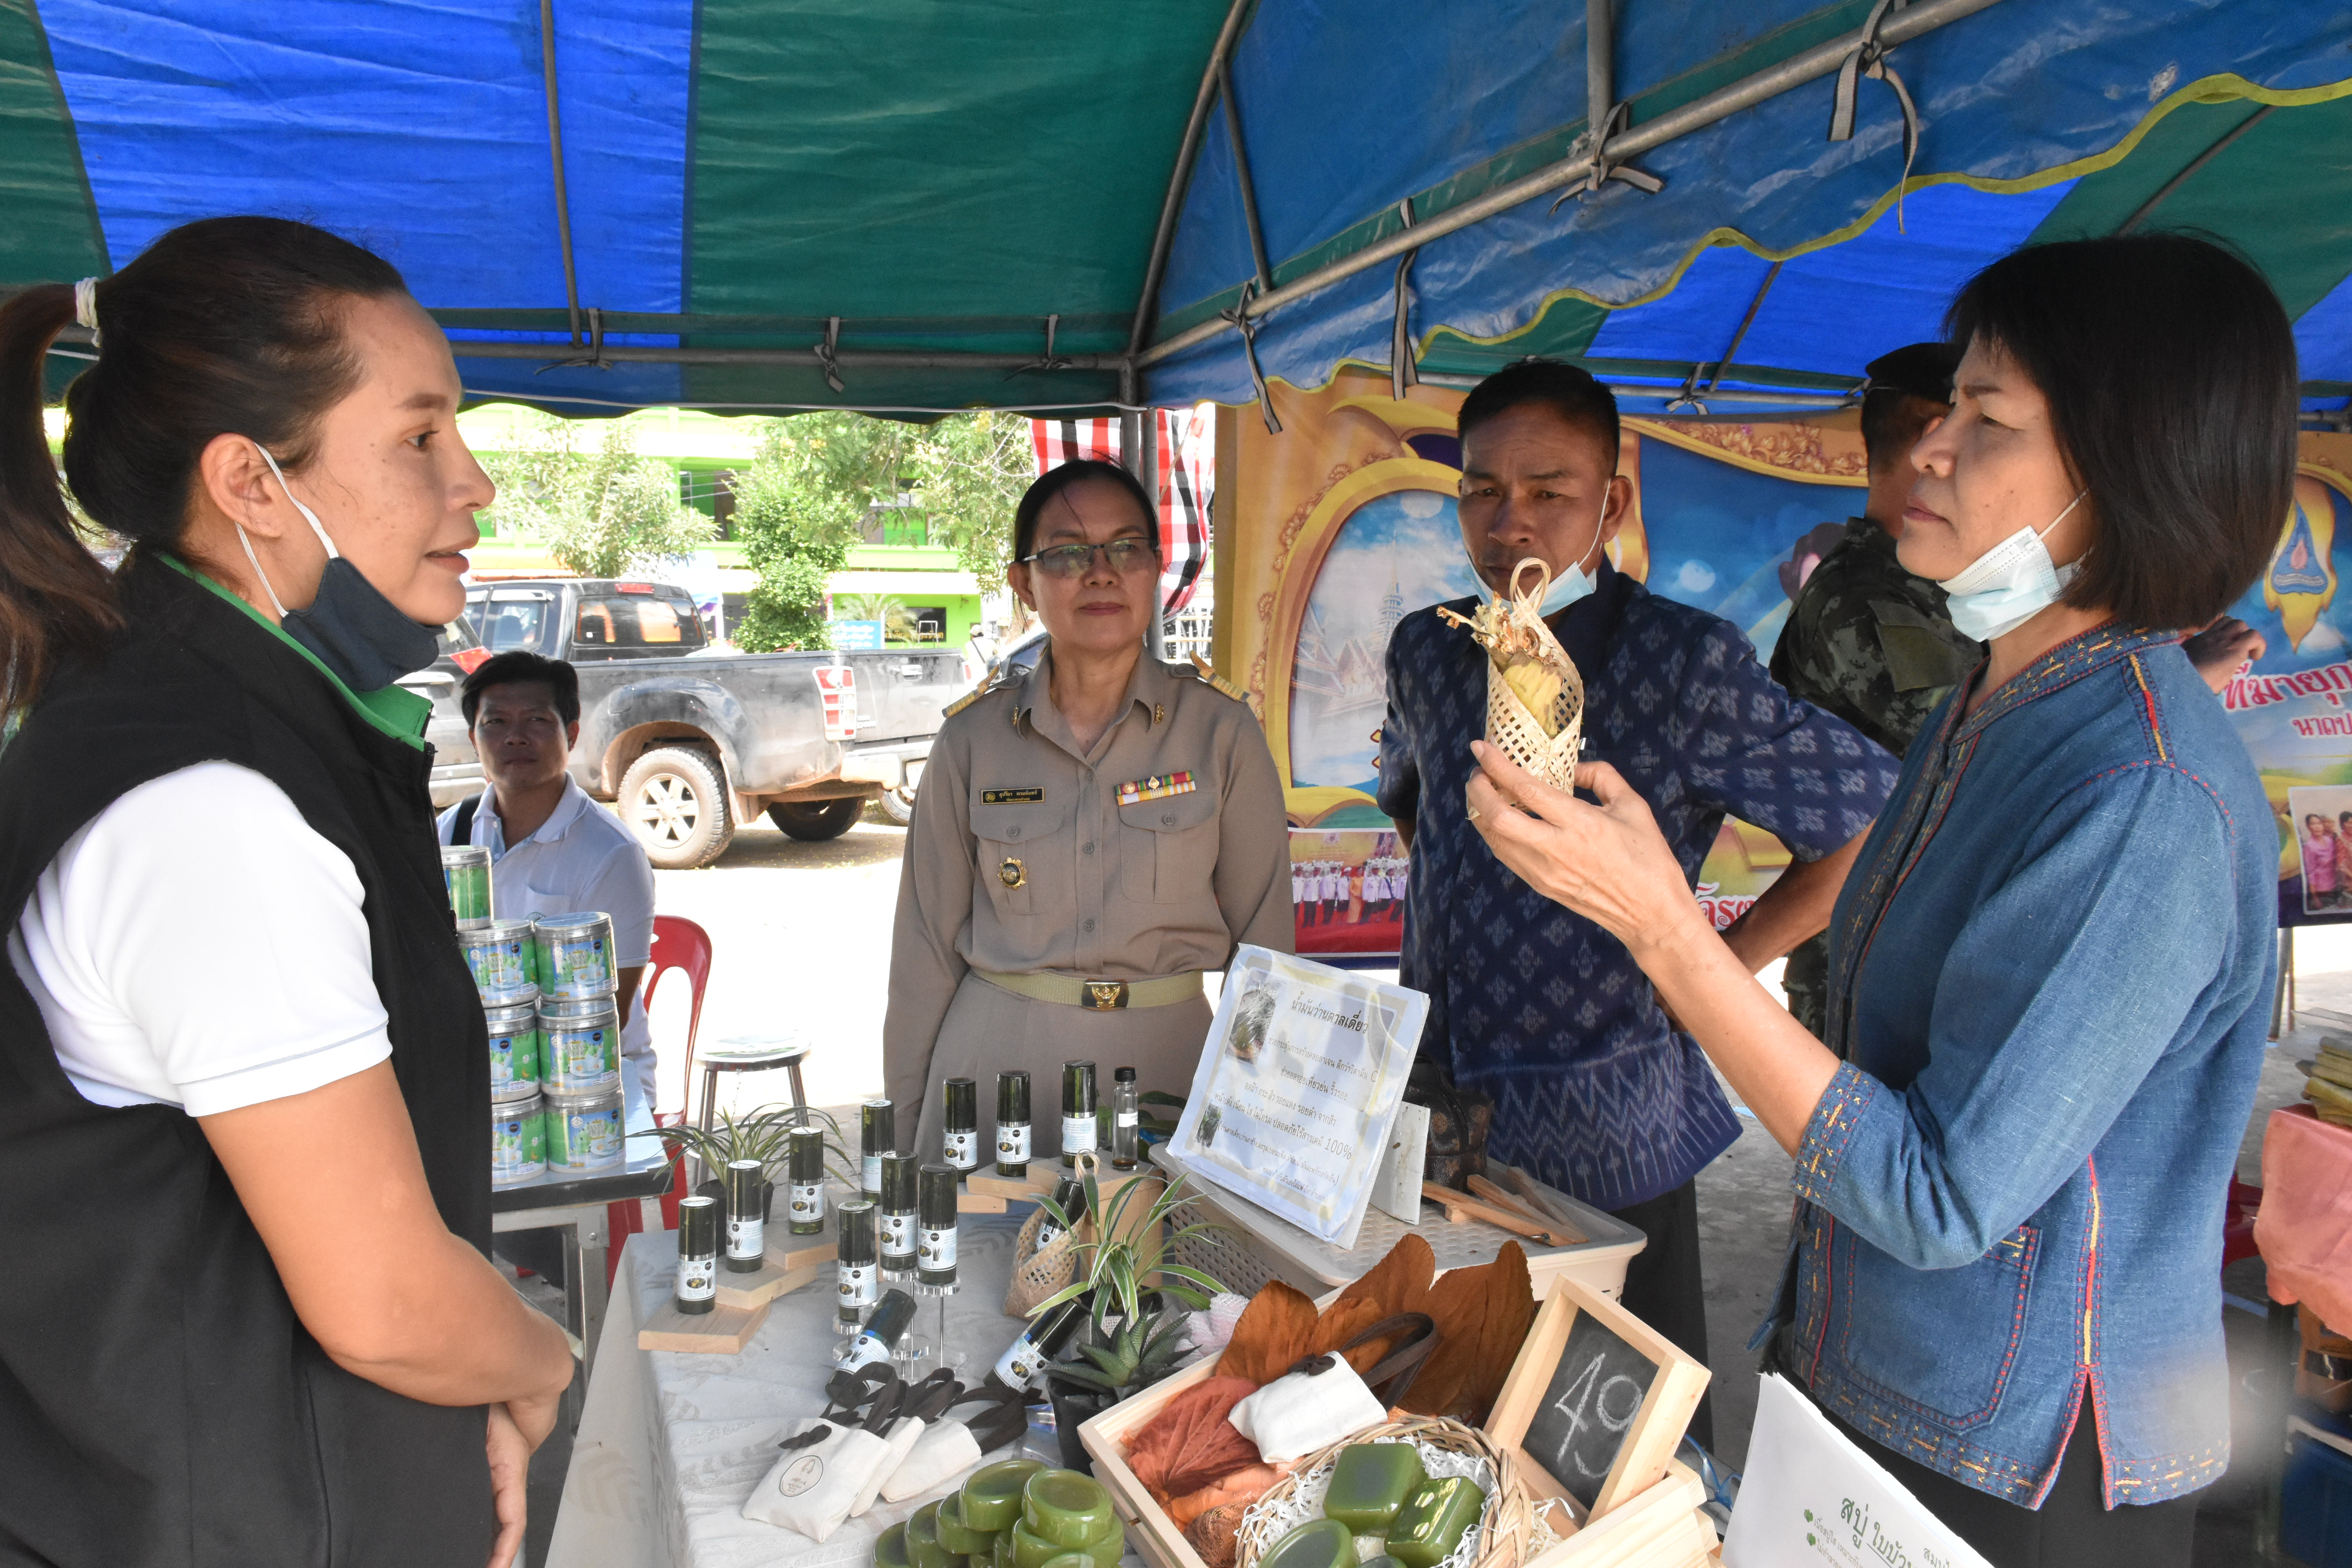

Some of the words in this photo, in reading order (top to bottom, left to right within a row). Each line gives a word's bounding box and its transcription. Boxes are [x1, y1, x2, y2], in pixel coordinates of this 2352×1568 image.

[1291, 991, 1368, 1033] น้ำมันว่านตาลเดี่ยว
[1280, 1066, 1328, 1093] ช่วยลดรอยเหี่ยวย่น
[1330, 1081, 1348, 1101] ริ้วรอย
[1258, 1089, 1268, 1098] กระ
[1276, 1096, 1296, 1111] รอยแดง
[1298, 1103, 1317, 1119] รอยดำ
[1318, 1112, 1337, 1127] จากสิว
[1273, 1119, 1323, 1147] ปลอดภัยไร้สารเคมี
[1325, 1138, 1352, 1160] 100%
[1841, 1497, 1869, 1550] สบู่
[1873, 1521, 1916, 1568] ใบบัว
